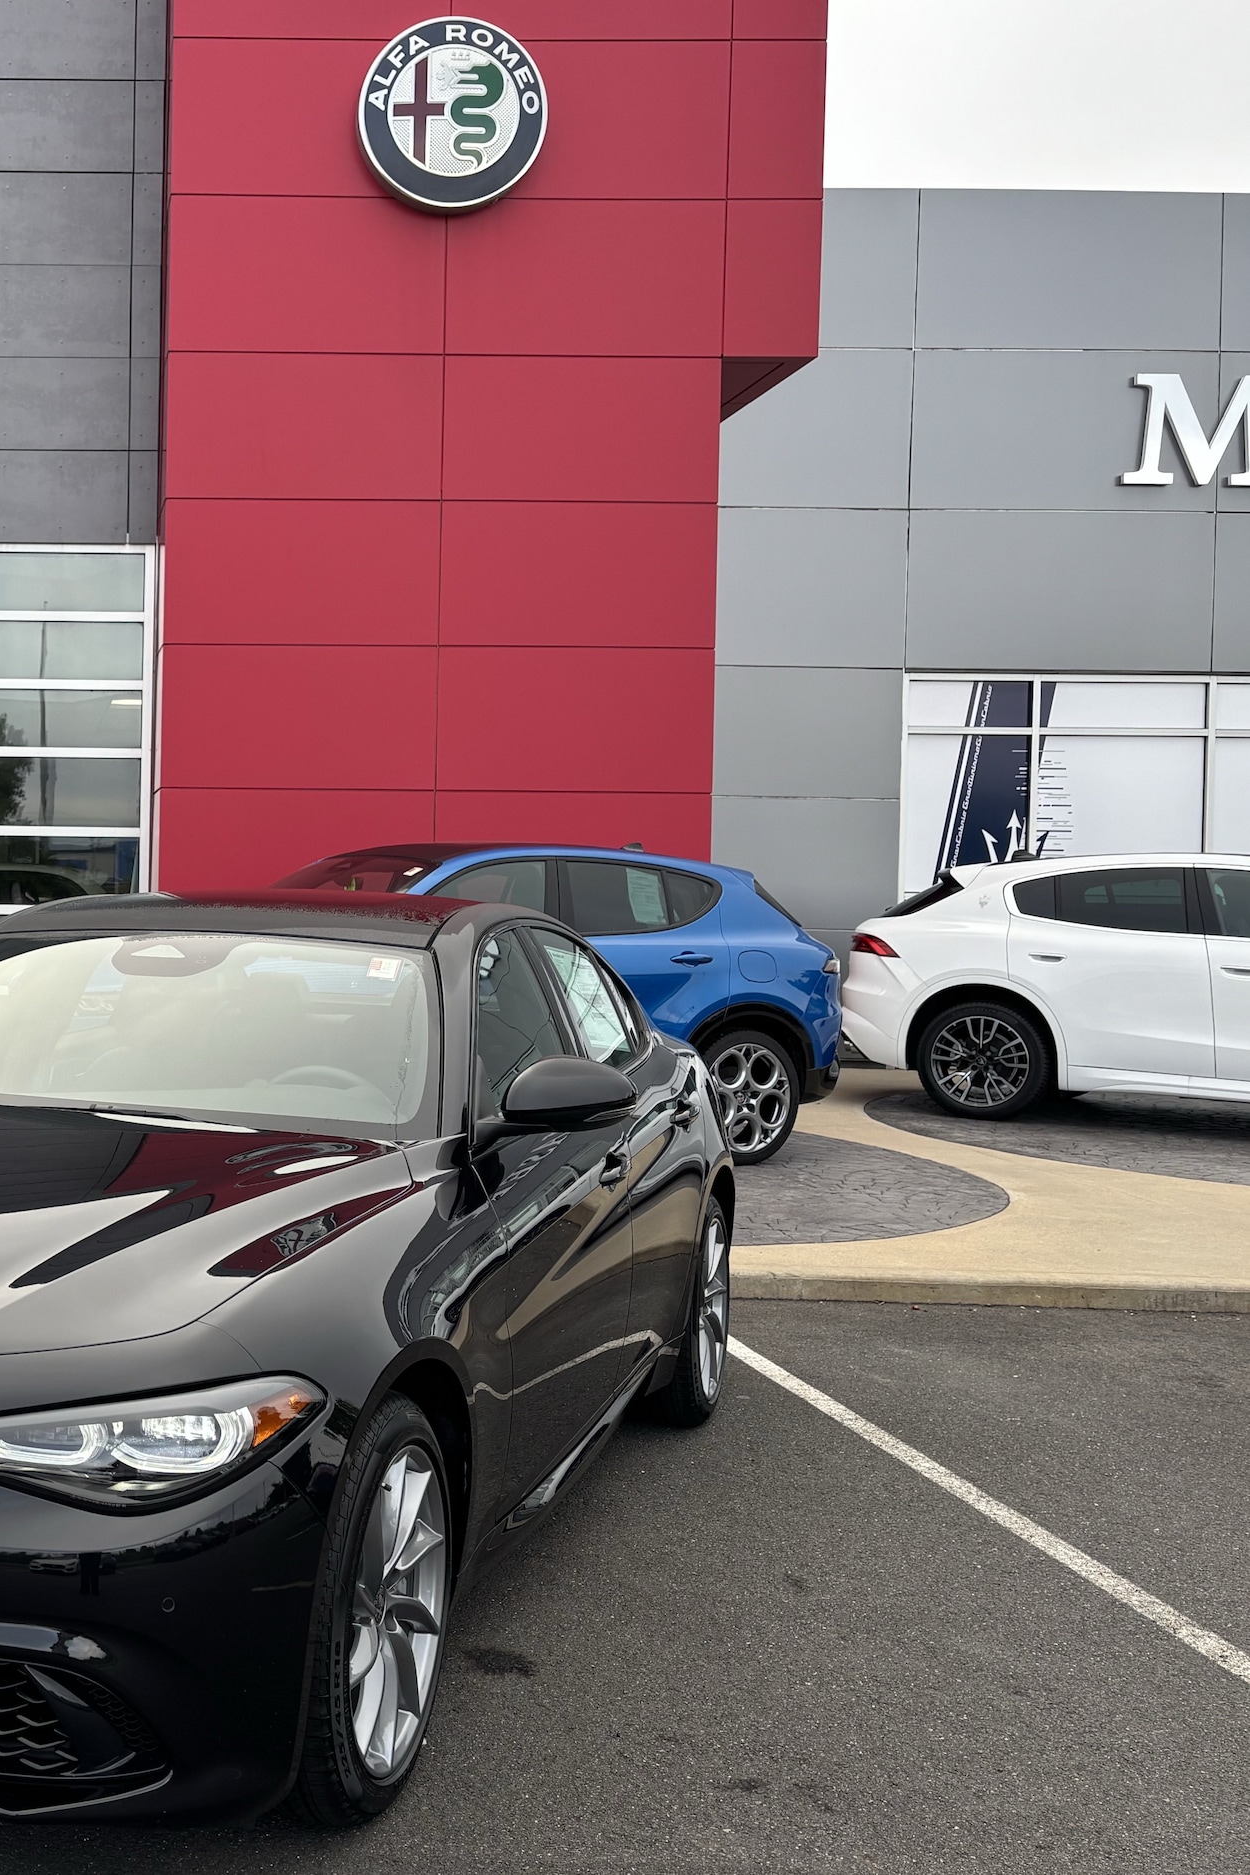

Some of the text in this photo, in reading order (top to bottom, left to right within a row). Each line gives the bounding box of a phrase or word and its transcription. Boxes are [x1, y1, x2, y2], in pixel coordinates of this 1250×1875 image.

[368, 24, 540, 115] ALFA ROMEO
[1120, 373, 1250, 487] M
